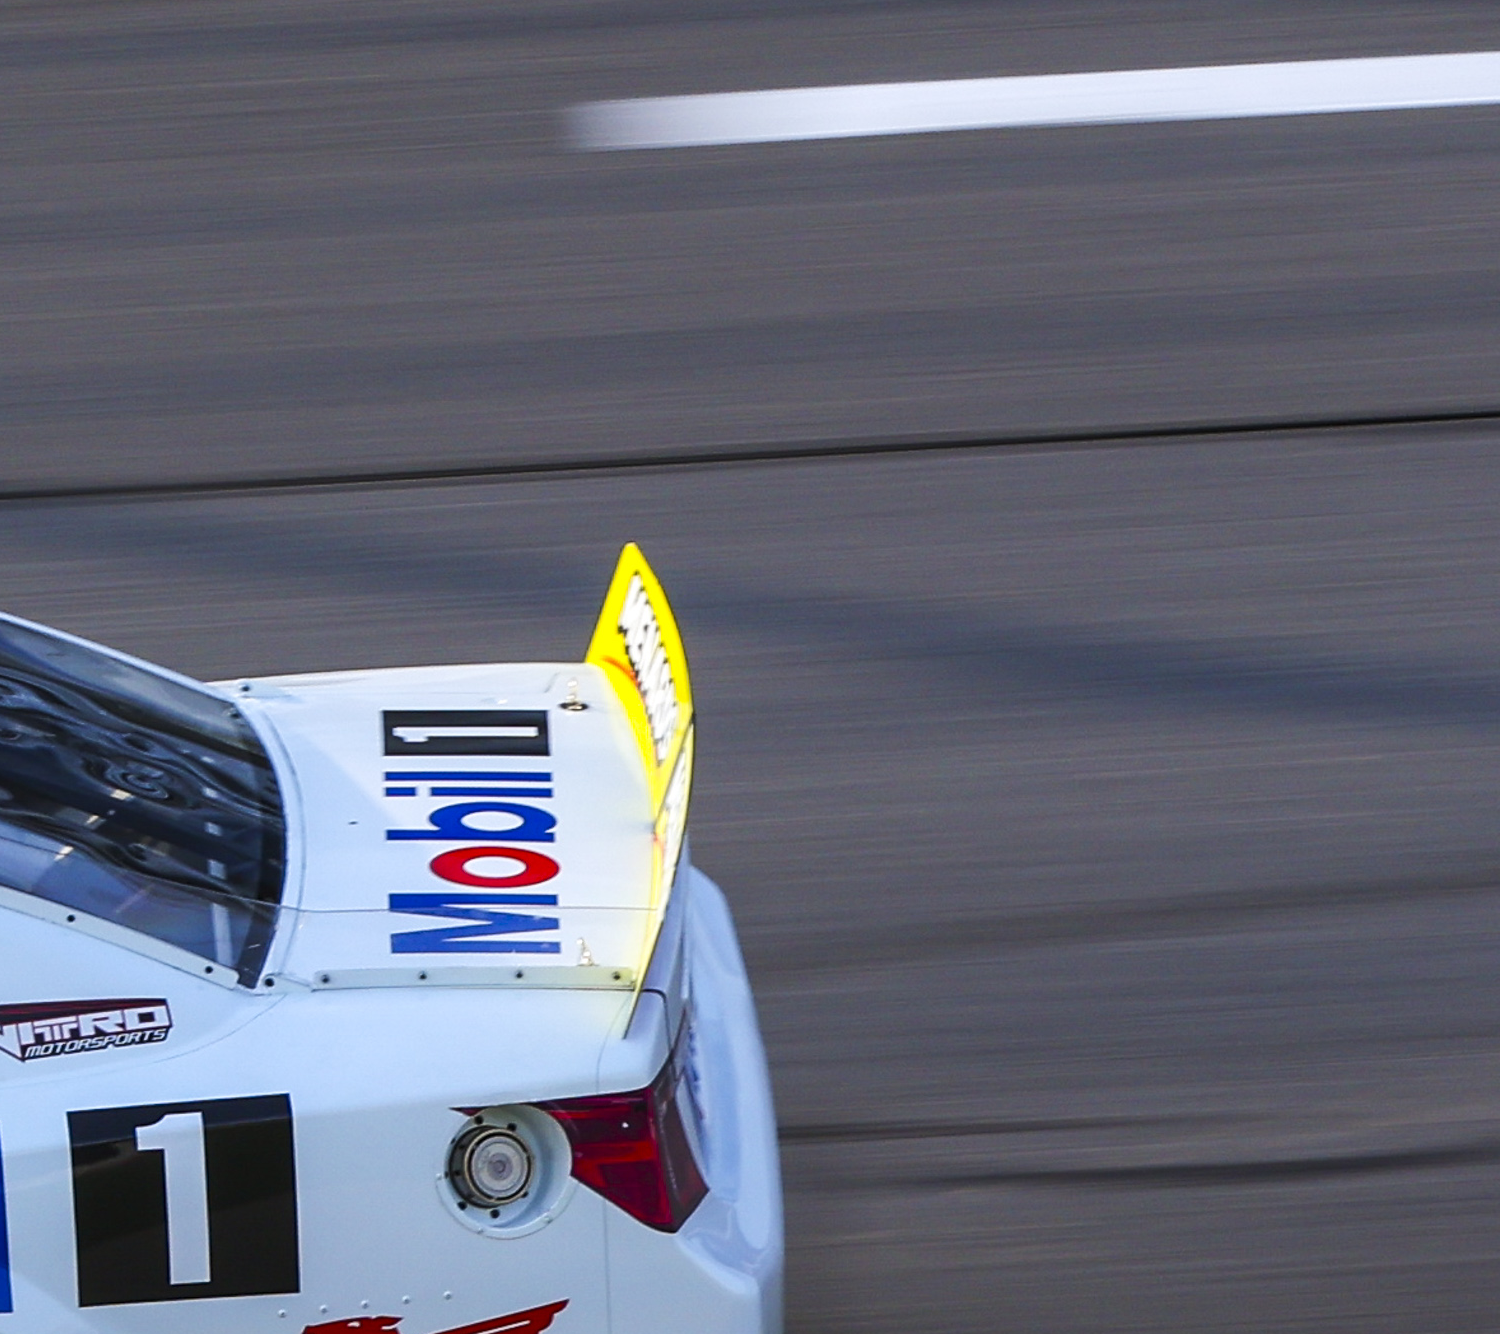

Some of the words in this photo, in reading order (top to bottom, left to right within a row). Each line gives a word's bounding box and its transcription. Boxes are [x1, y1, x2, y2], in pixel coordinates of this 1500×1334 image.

[383, 771, 561, 954] Mobil
[25, 1028, 167, 1058] MOTORSPORTS
[134, 1113, 213, 1286] 1
